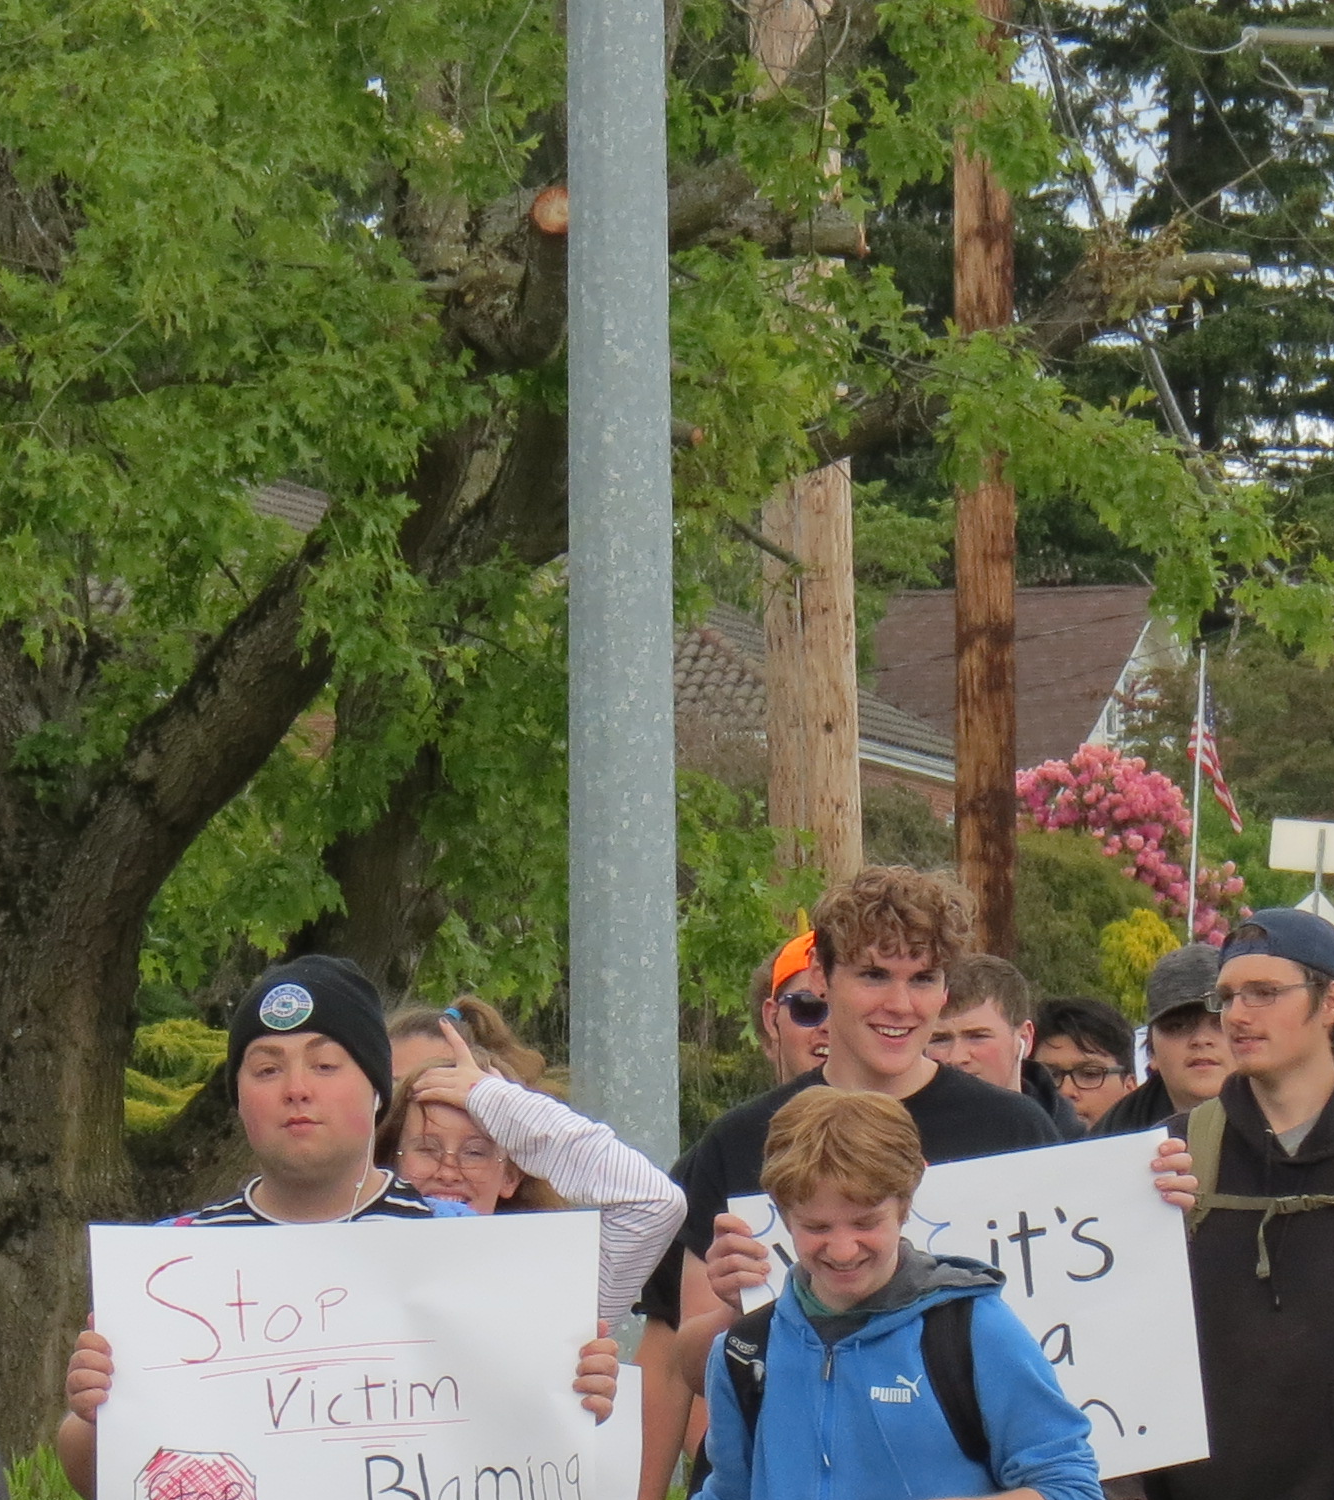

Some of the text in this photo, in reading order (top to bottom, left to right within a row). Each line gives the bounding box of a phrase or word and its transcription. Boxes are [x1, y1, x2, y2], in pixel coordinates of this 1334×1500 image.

[986, 1205, 1115, 1299] it's
[266, 1373, 462, 1430] Victim
[870, 1385, 912, 1403] PUMA
